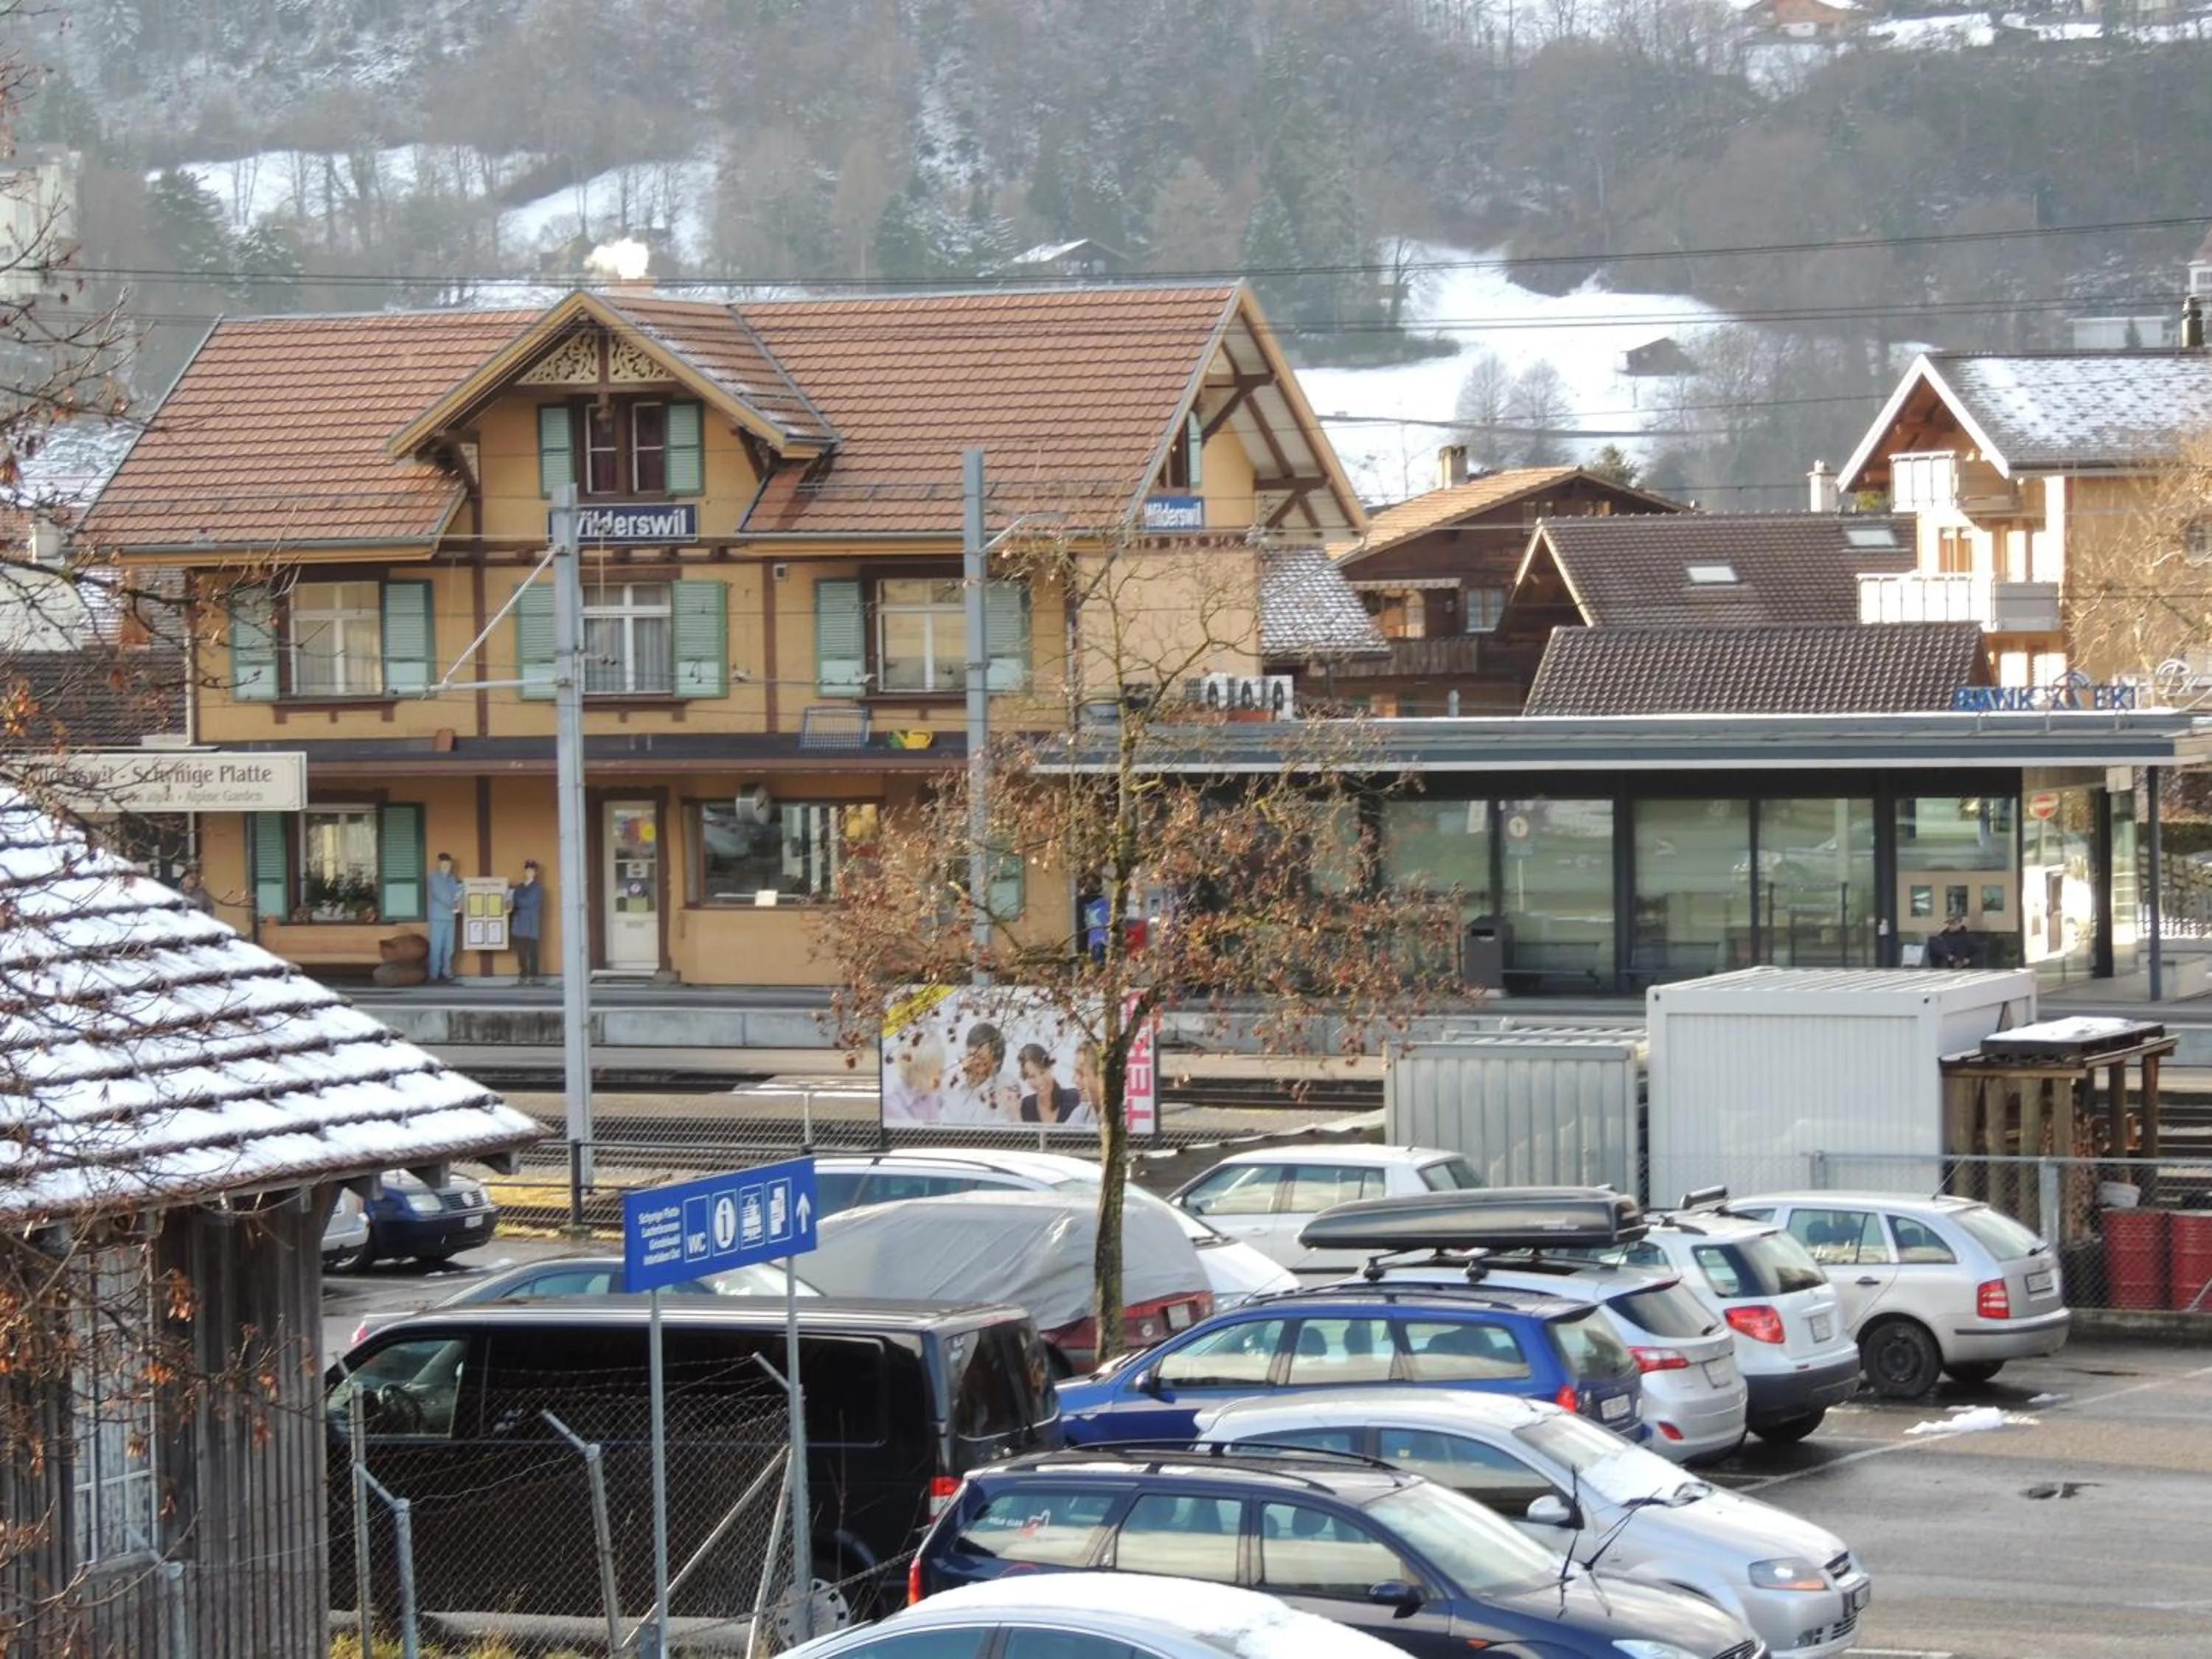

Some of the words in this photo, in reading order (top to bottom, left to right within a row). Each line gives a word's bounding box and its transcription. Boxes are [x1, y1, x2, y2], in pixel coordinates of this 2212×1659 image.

[577, 508, 687, 536] ilderswil
[1955, 686, 2036, 711] BANK
[220, 765, 272, 782] Platte
[687, 1231, 706, 1254] WC
